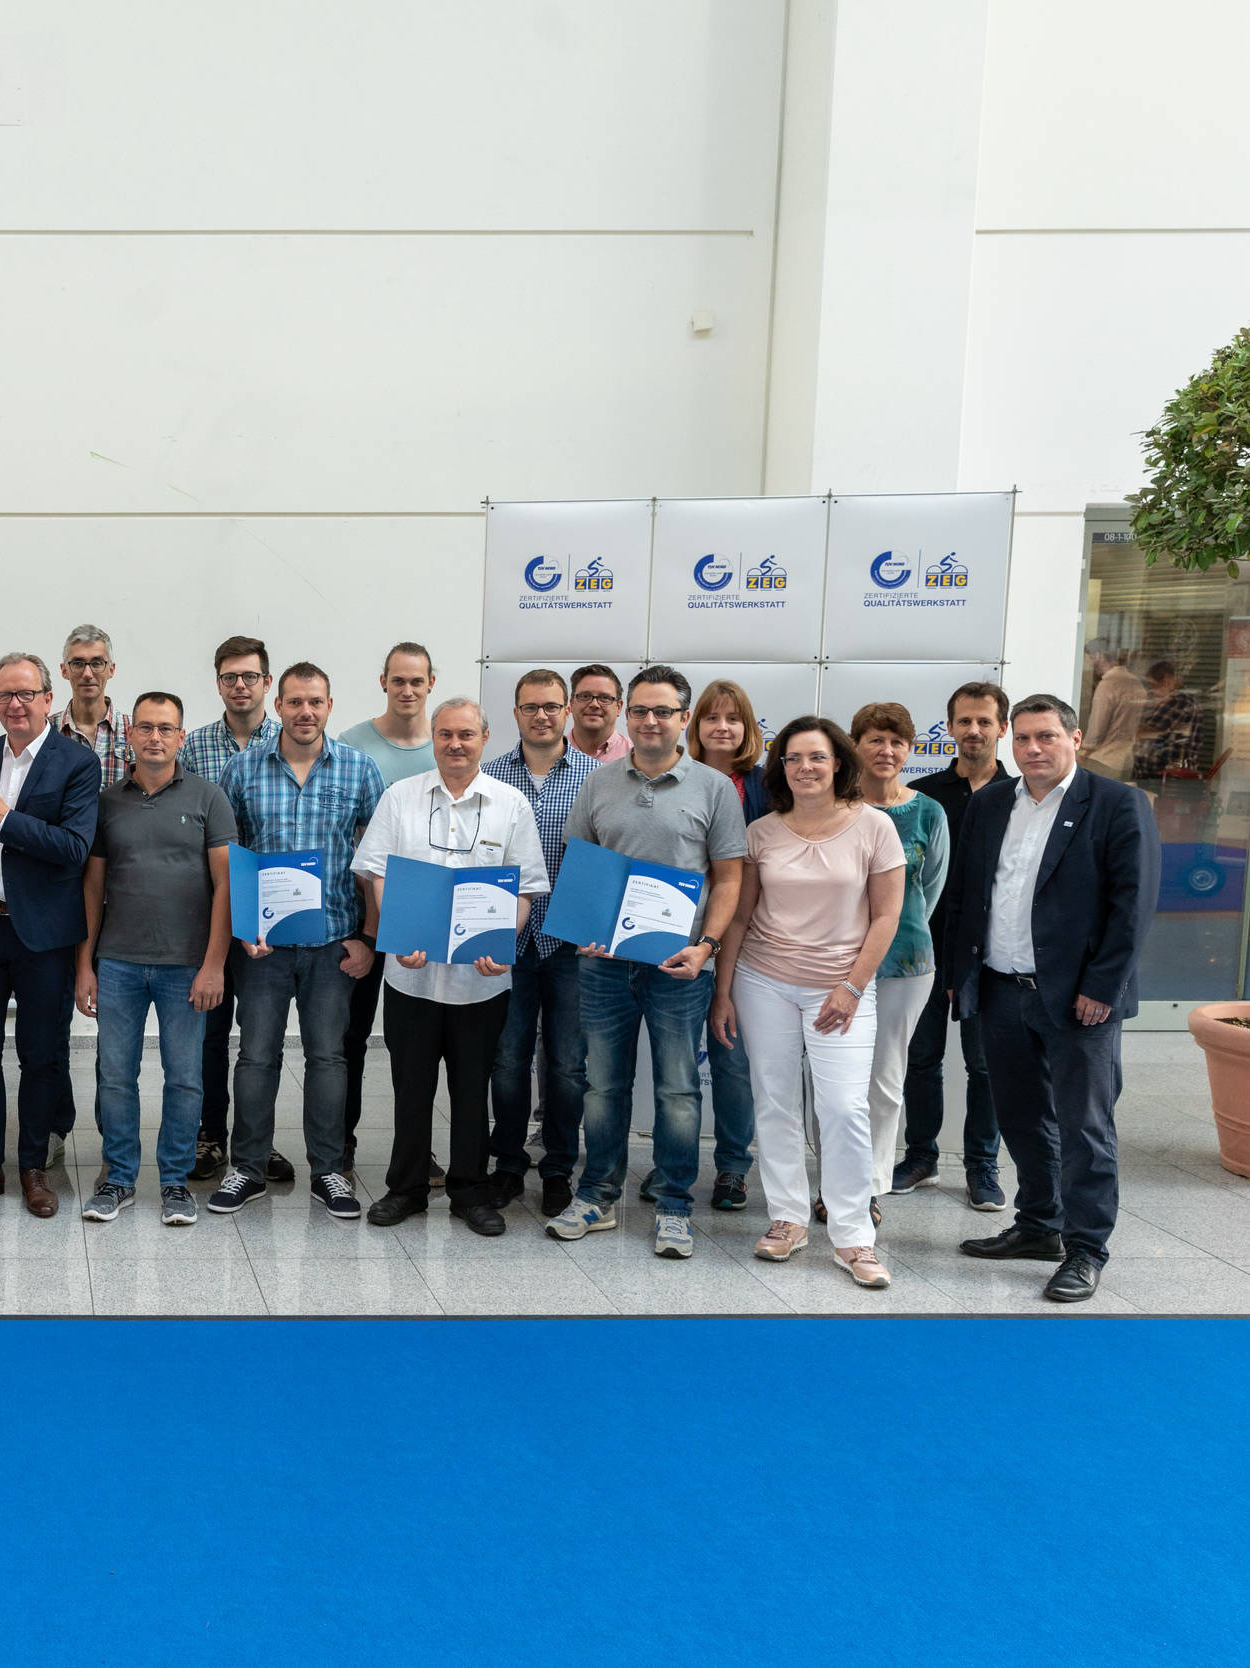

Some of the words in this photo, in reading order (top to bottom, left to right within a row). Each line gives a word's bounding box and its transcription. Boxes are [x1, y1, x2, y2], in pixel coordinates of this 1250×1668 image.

[576, 579, 612, 589] ZEG
[748, 578, 785, 588] ZEG
[926, 576, 967, 586] ZEG
[688, 600, 786, 608] QUALITÄTSWERKSTATT
[915, 744, 955, 754] ZEG
